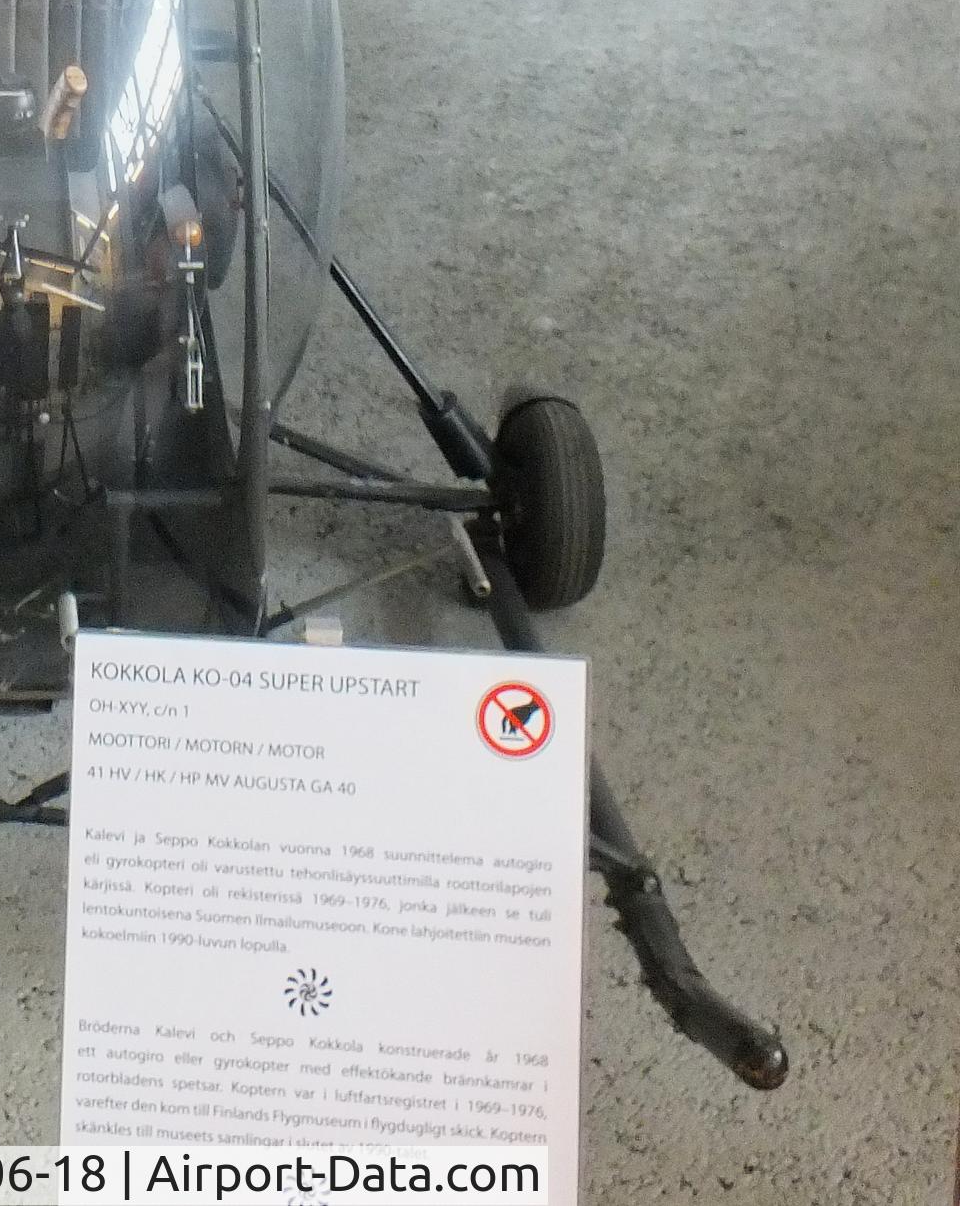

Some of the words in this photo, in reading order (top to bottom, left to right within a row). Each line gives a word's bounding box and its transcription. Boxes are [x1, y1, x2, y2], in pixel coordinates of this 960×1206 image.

[92, 662, 186, 684] KOKKOLA
[193, 668, 252, 688] KO-04
[259, 671, 323, 693] SUPER
[330, 677, 420, 697] UPSTART
[89, 698, 150, 717] OH-XYY,
[154, 703, 177, 717] c/n
[183, 706, 189, 718] 1
[89, 733, 170, 749] MOOTTORI
[175, 738, 181, 751] /
[186, 738, 253, 755] MOTORN
[258, 743, 264, 755] /
[268, 744, 325, 759] MOTOR
[88, 766, 103, 778] 41
[110, 768, 131, 780] HV
[146, 770, 166, 782] HK
[181, 772, 200, 785] HP
[206, 773, 230, 787] MV
[234, 775, 305, 792] AUGUSTA
[311, 779, 332, 793] GA
[337, 781, 356, 795] 40
[86, 828, 125, 842] Kalevi
[134, 831, 146, 846] ja
[155, 832, 198, 847] Seppo
[208, 835, 270, 851] Kokkolan
[280, 845, 331, 857] vuonna
[343, 845, 374, 858] 1968
[384, 850, 483, 865] suunnittelema
[494, 858, 552, 873] autogiro
[85, 853, 100, 864] eli
[106, 855, 185, 870] gyrokopteri
[192, 861, 208, 872] oli
[215, 864, 284, 877] varustettu
[291, 867, 440, 888] tehonlisäyssuuttimilla
[447, 879, 552, 898] roottorilapojen
[83, 877, 135, 894] kärjissä.
[145, 882, 193, 898] Kopteri
[203, 886, 219, 898] oli
[228, 888, 302, 903] rekisterissä
[399, 900, 437, 914] jonka
[446, 902, 496, 917] jälkeen
[506, 909, 520, 919] se
[529, 909, 551, 921] tuli
[82, 927, 156, 944] kokoelmiin
[162, 933, 237, 949] 1990-luvun
[241, 937, 290, 954] lopulla.
[83, 902, 191, 921] lentokuntoisena
[196, 909, 251, 924] Suomen
[373, 922, 408, 936] Kone
[411, 924, 490, 942] lahjoitettiin
[494, 932, 551, 946] museon
[79, 1019, 140, 1035] Bröderna
[155, 1025, 195, 1039] Kalevi
[211, 1030, 235, 1042] och
[250, 1032, 294, 1048] Seppo
[309, 1036, 363, 1052] Kokkola
[378, 1041, 470, 1061] konstruerade
[485, 1049, 499, 1063] år
[516, 1052, 549, 1067] 1968
[78, 1047, 96, 1058] ett
[107, 1048, 164, 1064] autogiro
[174, 1052, 203, 1065] eller
[214, 1056, 290, 1072] gyrokopter
[300, 1062, 330, 1075] med
[342, 1065, 432, 1083] effektökande
[444, 1074, 533, 1091] brännkamrar
[77, 1071, 163, 1088] rotorbladens
[172, 1078, 223, 1092] spetsar.
[232, 1082, 286, 1098] Koptern
[295, 1088, 315, 1099] var
[335, 1089, 446, 1110] luftfartsregistret
[75, 1121, 132, 1135] skänkles
[136, 1126, 152, 1138] till
[157, 1128, 214, 1142] museets
[218, 1133, 284, 1149] samlingar
[76, 1097, 128, 1109] varefter
[131, 1099, 157, 1112] den
[160, 1102, 189, 1115] kom
[194, 1104, 209, 1116] till
[213, 1105, 269, 1121] Finlands
[274, 1110, 363, 1129] Flygmuseum
[371, 1117, 446, 1138] flygdugligt
[490, 1127, 547, 1144] Koptern
